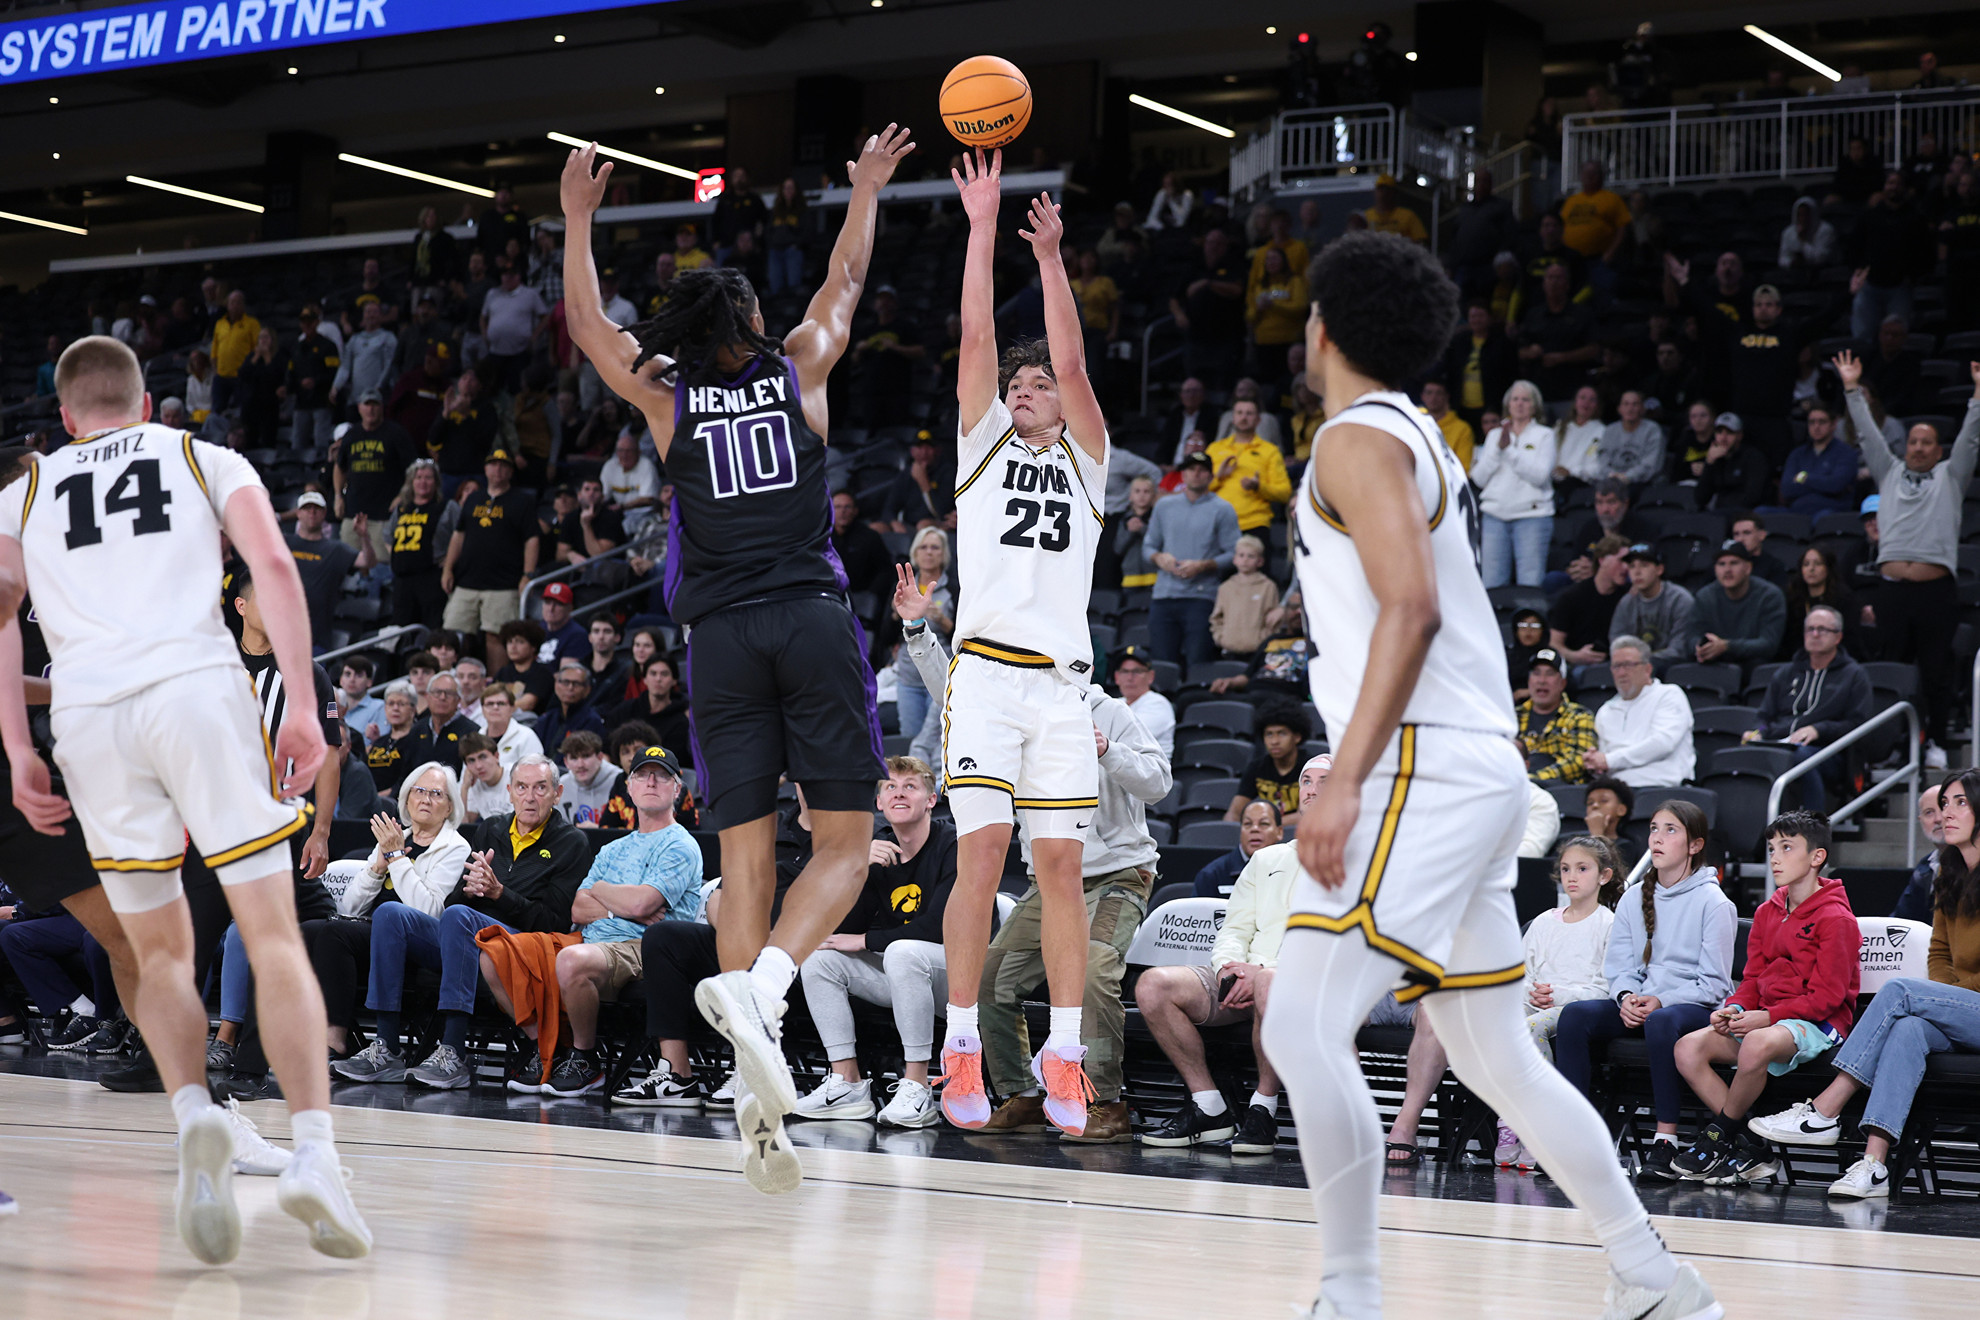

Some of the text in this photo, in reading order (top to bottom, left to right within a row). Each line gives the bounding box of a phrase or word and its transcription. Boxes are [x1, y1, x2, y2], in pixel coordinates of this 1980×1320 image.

[0, 0, 387, 76] SYSTEM PARTNER
[953, 113, 1015, 134] Wilson
[688, 376, 787, 413] HENLEY
[692, 410, 797, 499] 10
[1002, 459, 1073, 497] IOWA
[54, 458, 172, 551] 14
[1000, 498, 1071, 552] 23
[394, 524, 423, 553] 22
[1161, 913, 1212, 929] Modern
[1154, 941, 1188, 951] FRATERNAL
[1159, 927, 1216, 944] Woodme
[1861, 936, 1886, 947] ern
[1860, 949, 1904, 962] dmen
[1864, 964, 1902, 972] FINANCIAL
